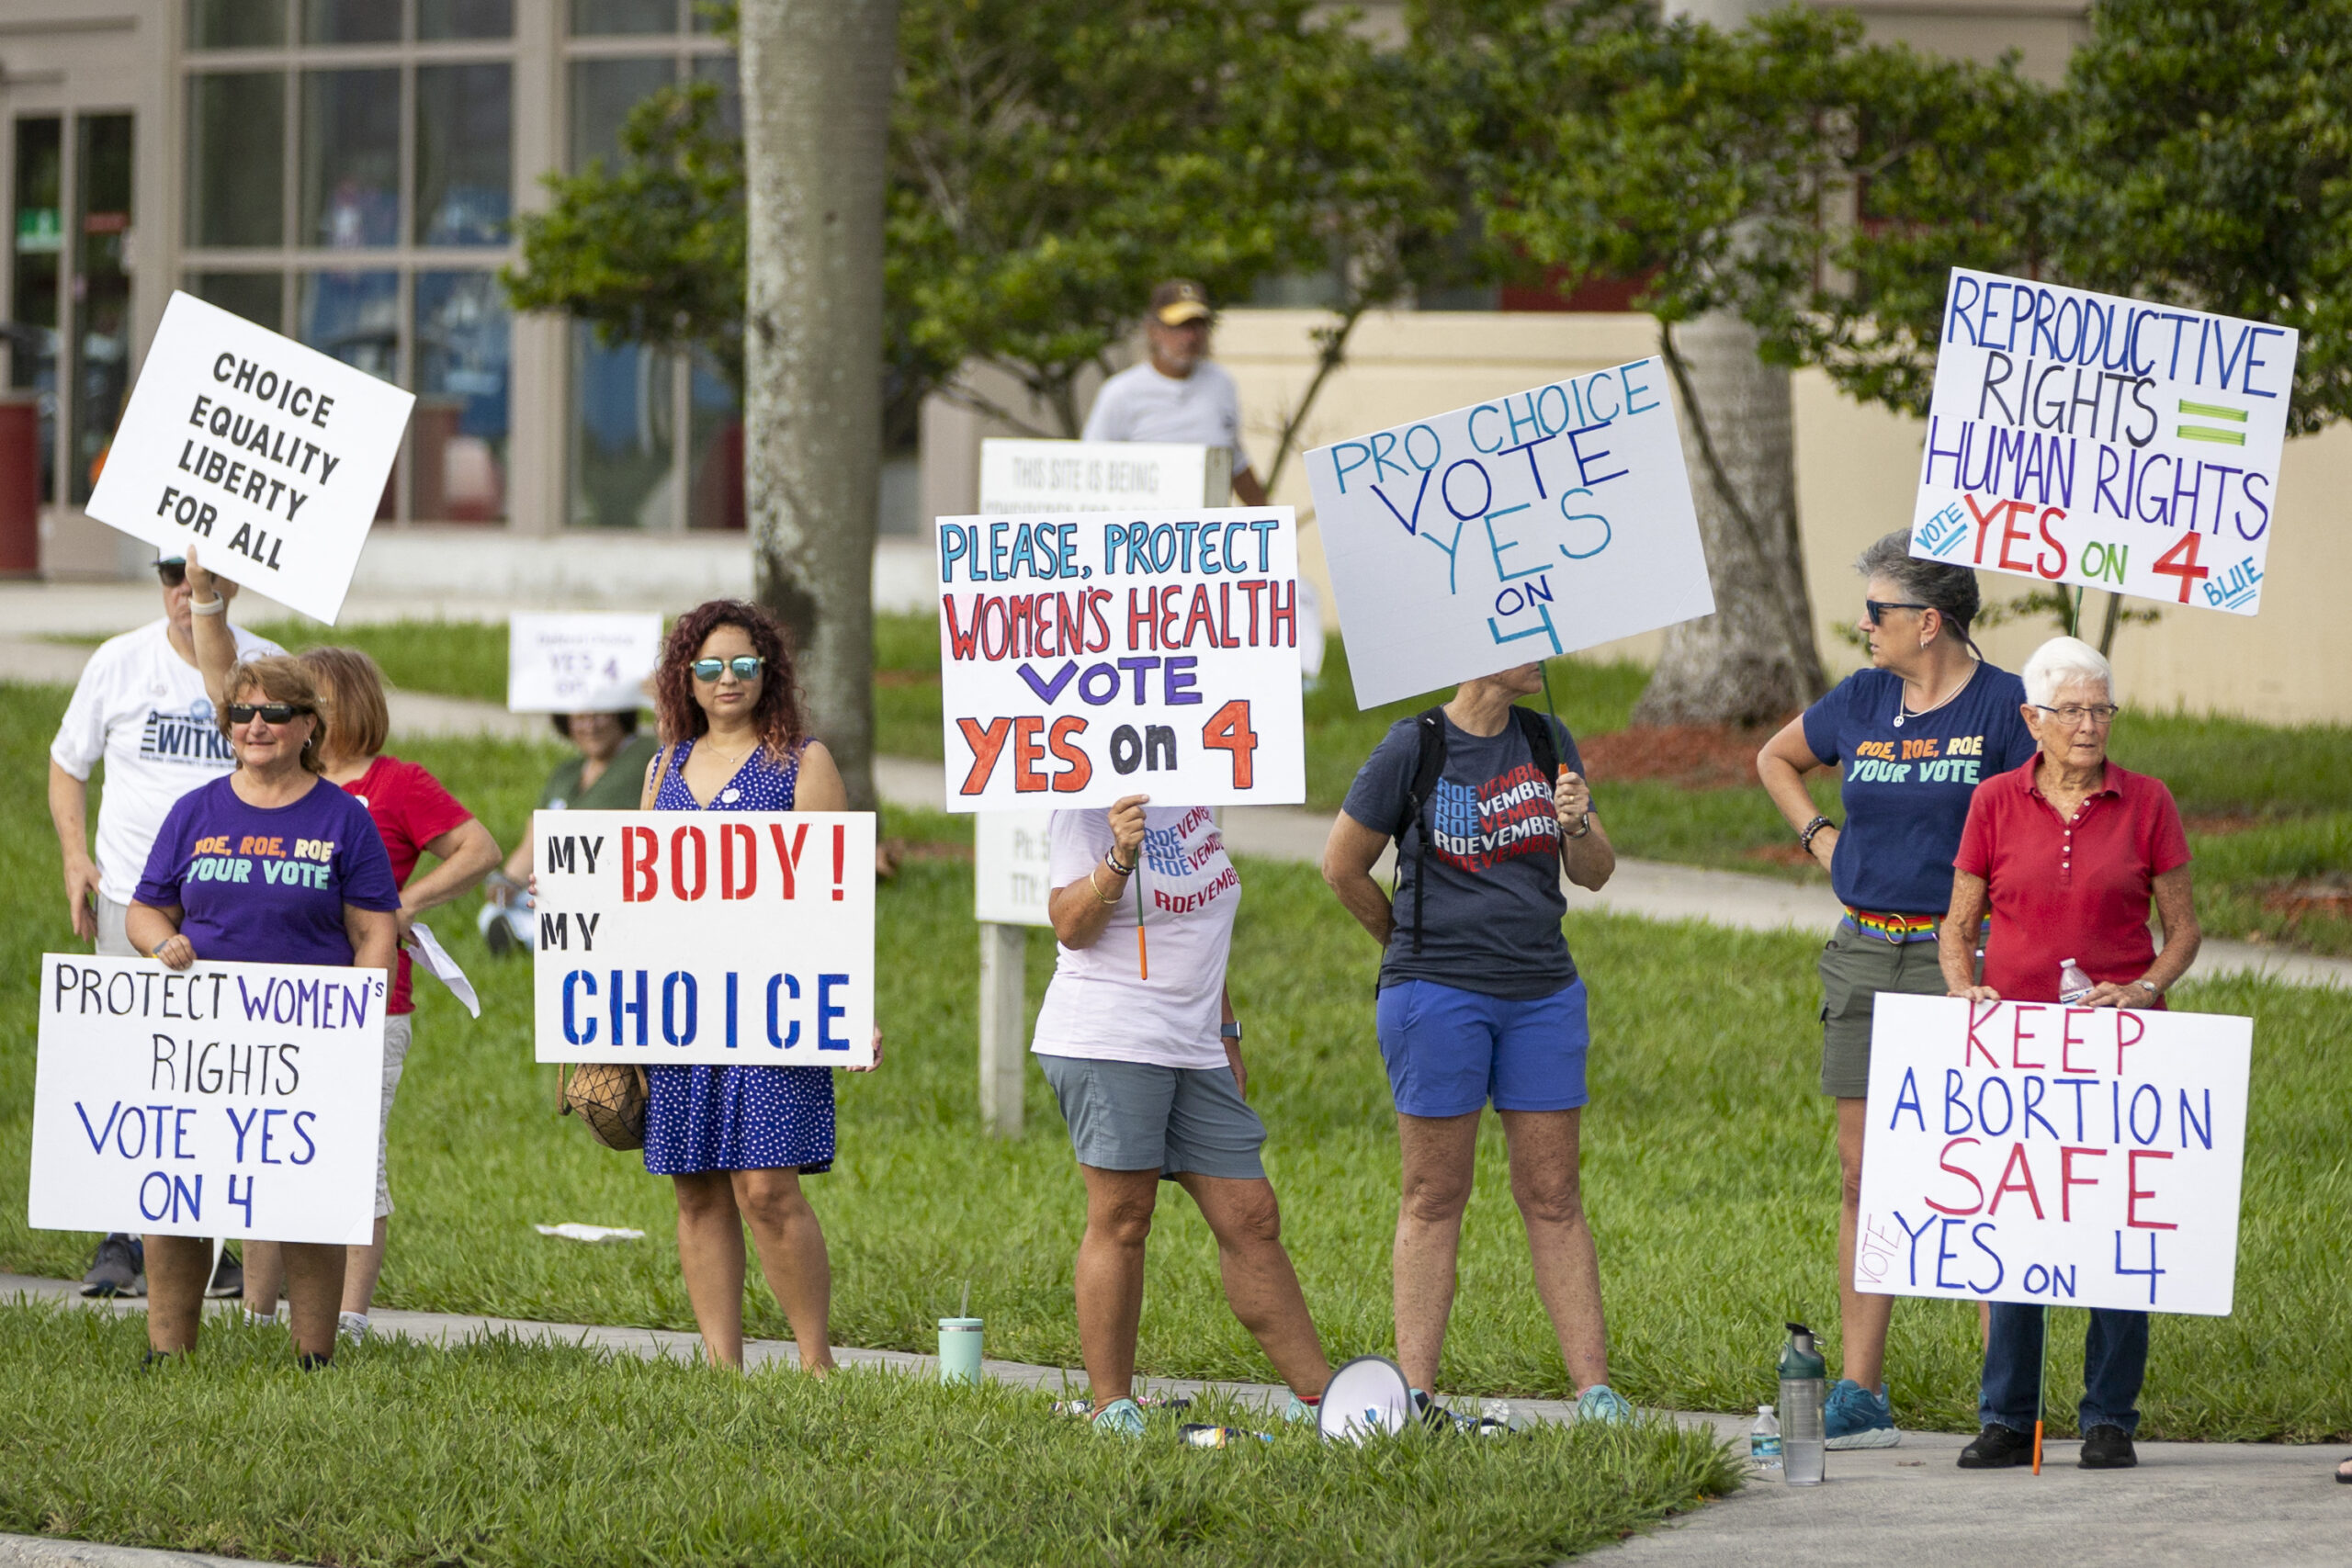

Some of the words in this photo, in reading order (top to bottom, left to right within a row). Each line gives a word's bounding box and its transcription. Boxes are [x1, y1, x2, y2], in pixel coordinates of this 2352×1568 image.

[1948, 276, 2285, 399] REPRODUCTIVE
[213, 352, 334, 428] CHOICE
[1331, 424, 1442, 494] PRO
[1468, 360, 1660, 454] CHOICE
[1978, 351, 2158, 448] RIGHTS
[189, 395, 339, 486] EQUALITY
[1013, 457, 1045, 490] THIS
[1049, 457, 1081, 492] SITE
[1086, 459, 1102, 492] IS
[1107, 461, 1159, 494] BEING
[1926, 415, 2076, 509] HUMAN
[2094, 444, 2269, 541] RIGHTS
[178, 439, 308, 522] LIBERTY
[1370, 421, 1629, 536] VOTE
[157, 485, 218, 537] FOR
[228, 522, 281, 571] ALL
[940, 522, 1091, 582] PLEASE,
[1104, 520, 1279, 575] PROTECT
[1420, 488, 1611, 595] YES
[1915, 502, 1964, 551] VOTE
[1964, 493, 2067, 580] YES
[2080, 541, 2129, 585] ON
[2152, 531, 2209, 604] 4
[1495, 574, 1555, 616] ON
[2203, 556, 2264, 606] BLUE
[943, 585, 1113, 661] WOMEN'S
[1128, 580, 1295, 651] HEALTH
[1487, 604, 1563, 655] 4
[1016, 656, 1203, 705] VOTE
[956, 715, 1092, 795] YES
[1110, 724, 1177, 775] on
[1202, 699, 1258, 790] 4
[1847, 760, 1912, 783] YOUR
[1919, 759, 1981, 784] VOTE
[1902, 739, 1940, 761] ROE,
[1946, 735, 1984, 756] ROE
[187, 857, 253, 884] YOUR
[263, 860, 331, 890] VOTE
[239, 836, 287, 859] ROE,
[294, 839, 334, 863] ROE
[548, 836, 605, 874] MY
[621, 823, 845, 902] BODY!
[540, 912, 600, 951] MY
[55, 963, 227, 1021] PROTECT
[562, 969, 850, 1051] CHOICE
[152, 1033, 300, 1095] RIGHTS
[1965, 1001, 2145, 1076] KEEP
[74, 1100, 196, 1159] VOTE
[226, 1107, 316, 1166] YES
[1890, 1066, 2212, 1150] ABORTION
[140, 1170, 203, 1224] ON
[228, 1174, 254, 1228] 4
[1924, 1136, 2178, 1231] SAFE
[1857, 1213, 1902, 1283] VOTE
[1893, 1211, 2005, 1295] YES
[2023, 1263, 2076, 1298] ON
[2115, 1230, 2166, 1304] 4
